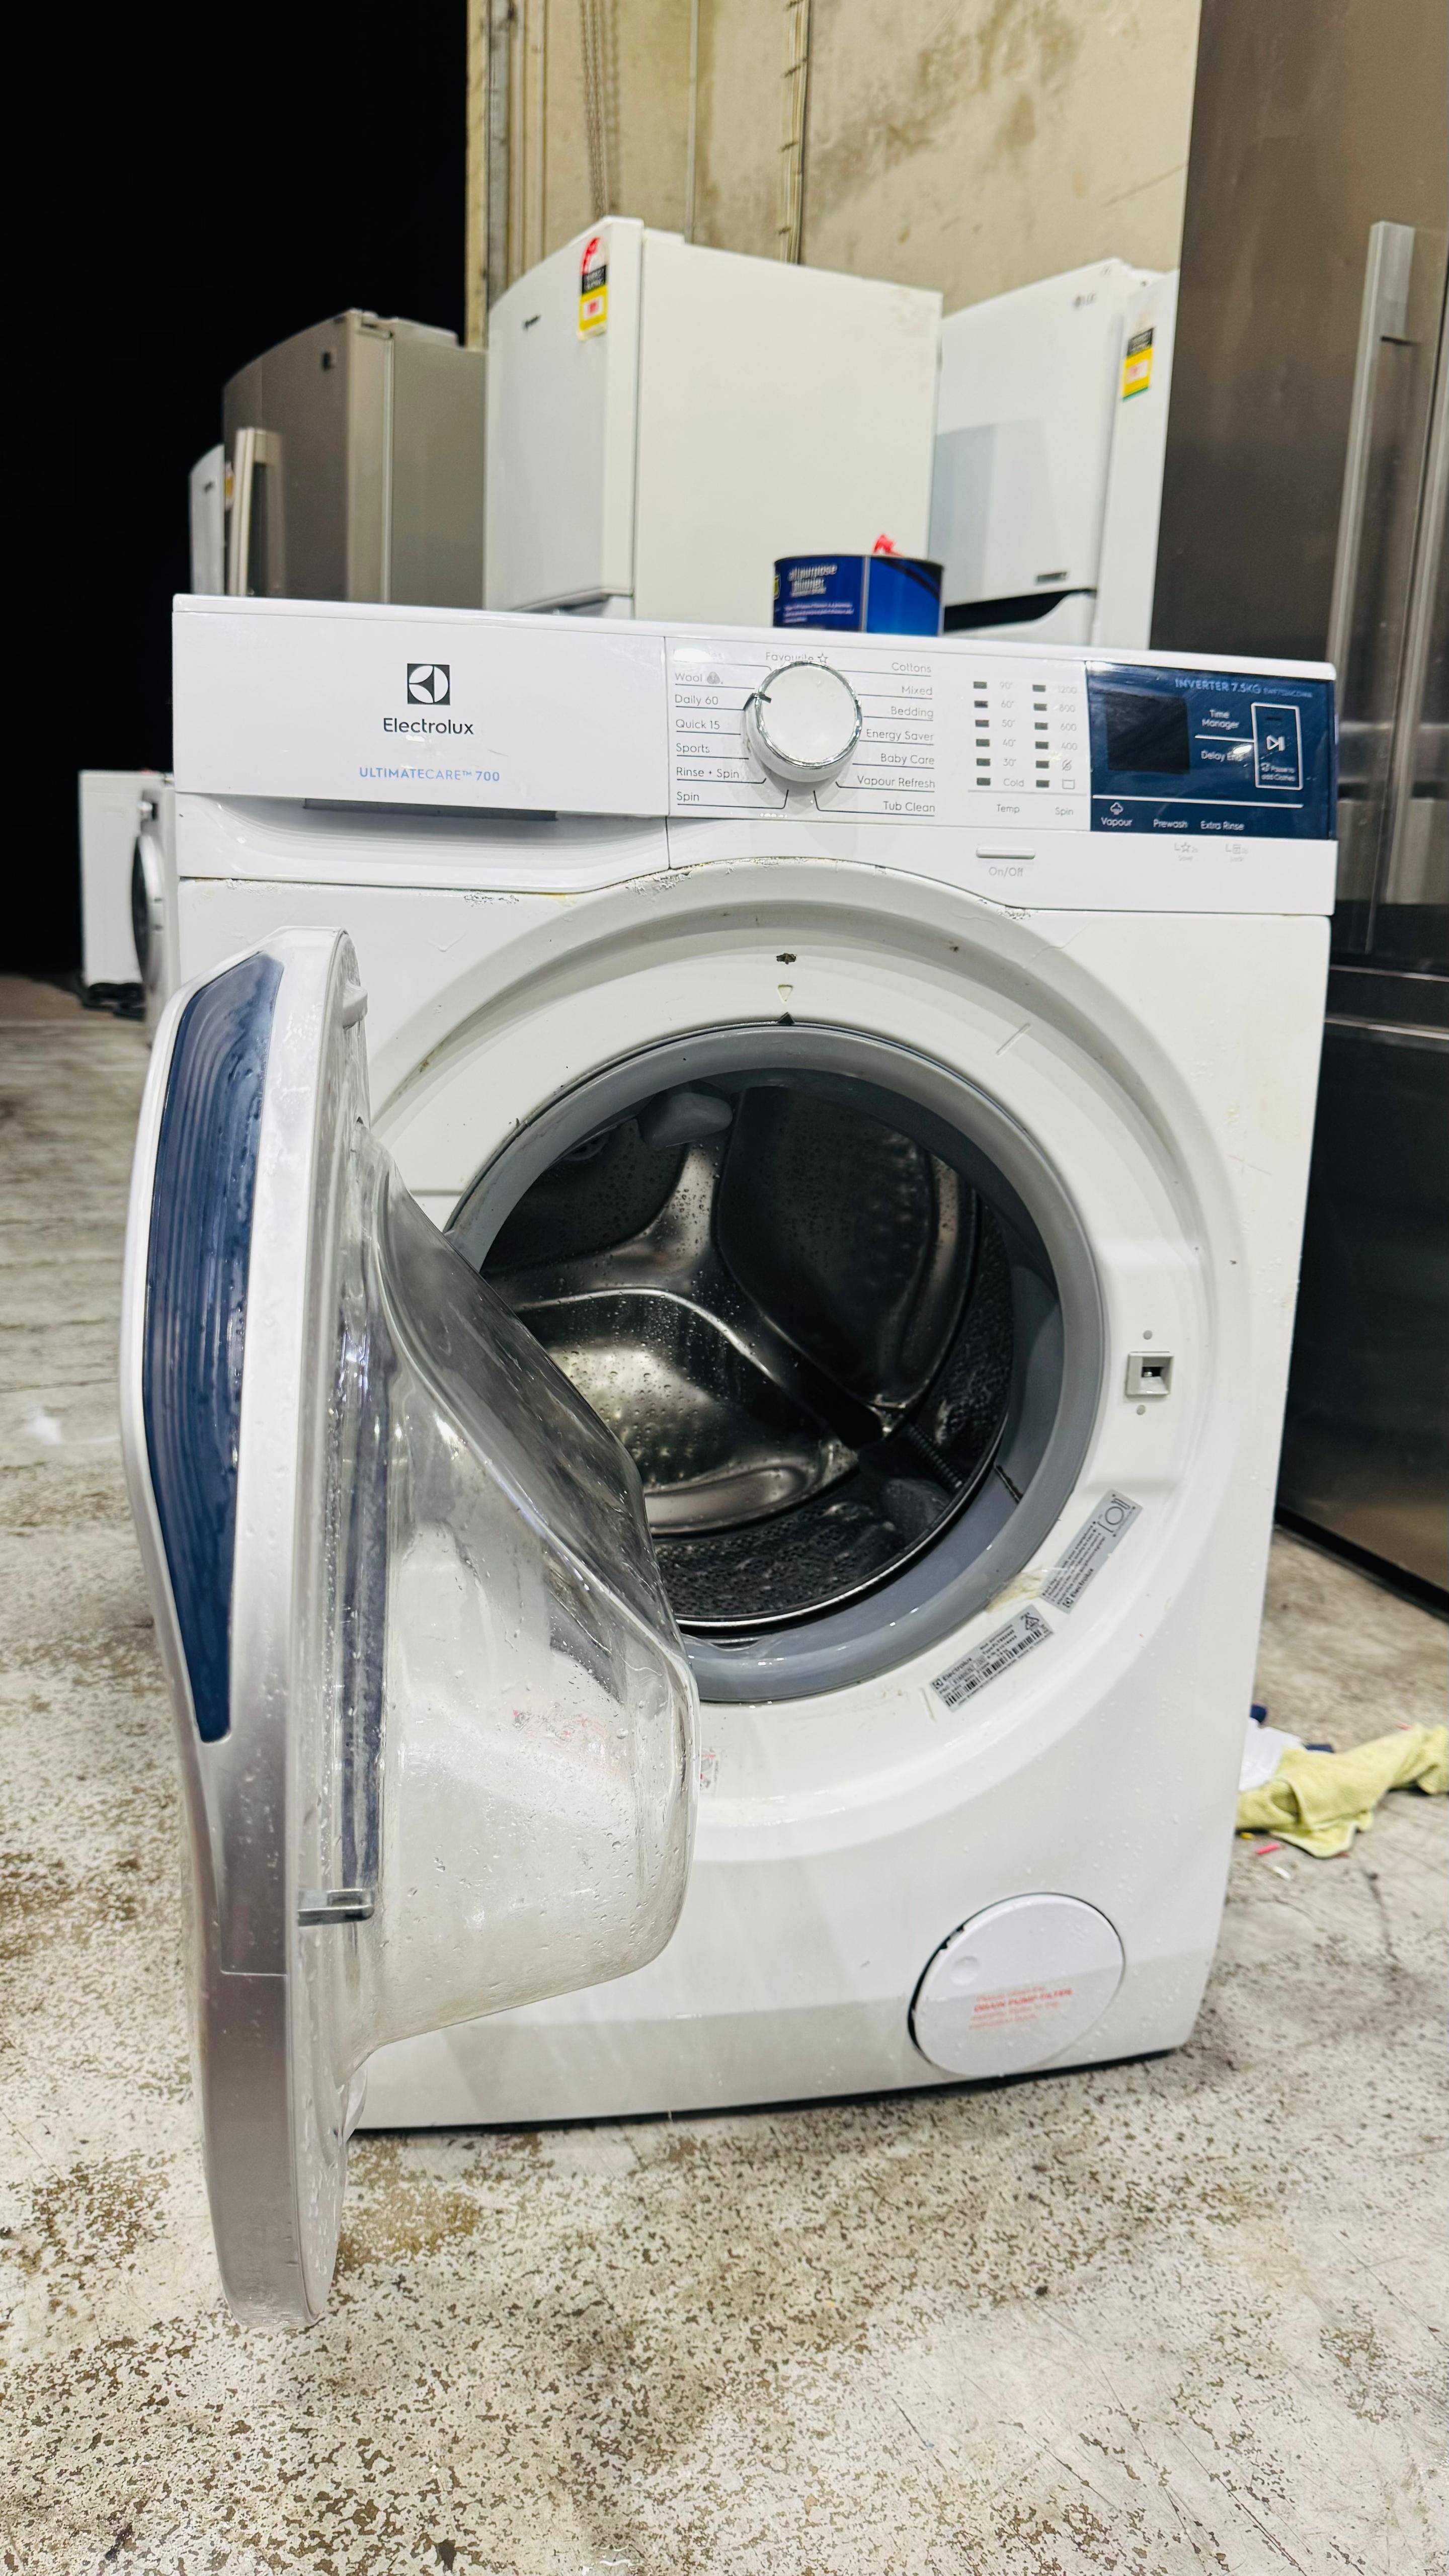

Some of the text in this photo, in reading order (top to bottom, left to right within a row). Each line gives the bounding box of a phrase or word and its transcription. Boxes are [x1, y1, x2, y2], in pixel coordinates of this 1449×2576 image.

[892, 662, 932, 673] Cottons
[675, 673, 702, 682] Wool
[902, 686, 932, 695] Mixed
[1175, 679, 1229, 692] INVERTER
[1232, 683, 1261, 694] 7.5KG
[675, 694, 718, 706] Daily 60
[891, 706, 933, 719] Bedding
[1210, 709, 1230, 718] Time
[383, 717, 474, 735] Electrolux
[676, 719, 720, 730] Quick 15
[1201, 719, 1240, 730] Manager
[866, 729, 934, 742] Energy Saver
[676, 743, 710, 753] Sports
[1061, 742, 1078, 751] 400
[881, 753, 935, 765] Baby Care
[1201, 750, 1225, 762] Delay
[476, 771, 500, 781] 700
[676, 767, 704, 777] Rinse
[717, 769, 740, 779] Spin
[857, 775, 935, 788] Vapour Refresh
[1003, 778, 1024, 787] Cold
[677, 791, 699, 802] Spin
[883, 801, 935, 812] Tub Clean
[997, 804, 1020, 814] Temp
[1055, 808, 1074, 816] Spin
[1101, 817, 1133, 827] Vapour
[1153, 819, 1188, 829] Prewash
[1200, 820, 1245, 831] Extra Rinse
[989, 867, 1023, 877] On/Off
